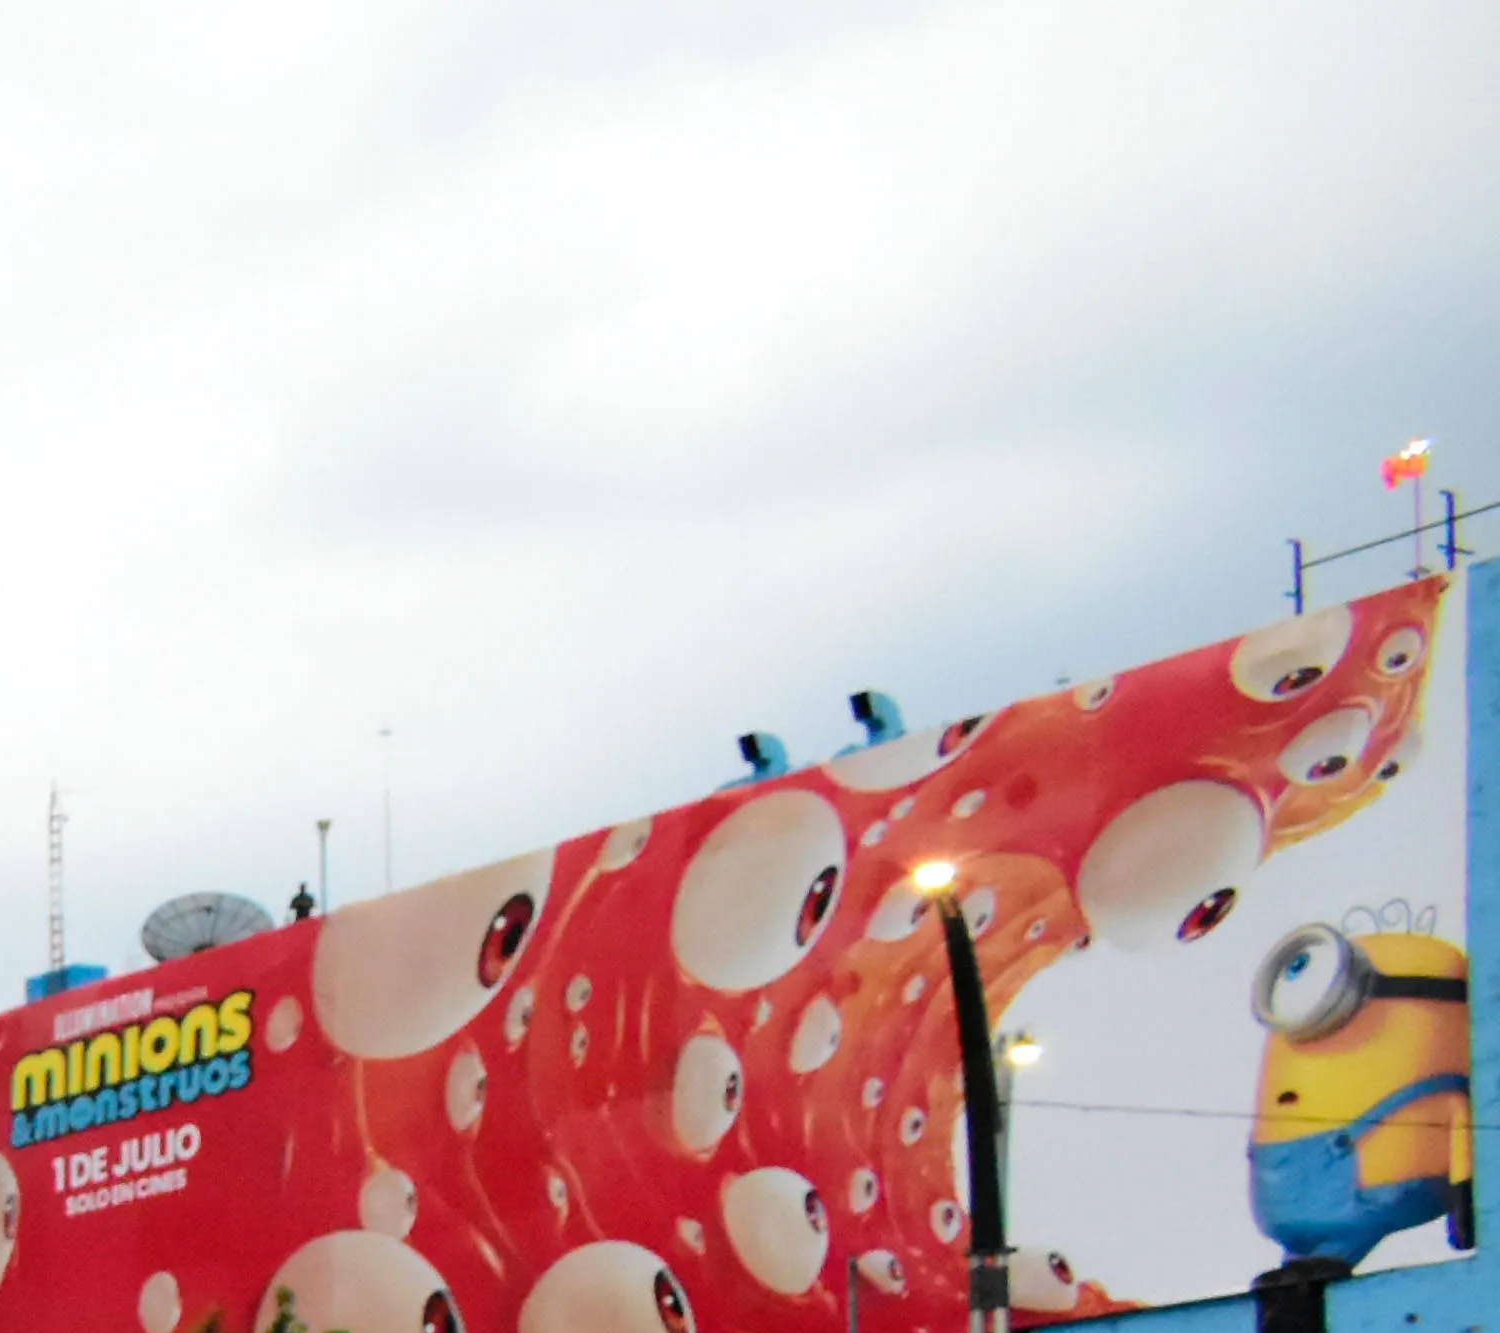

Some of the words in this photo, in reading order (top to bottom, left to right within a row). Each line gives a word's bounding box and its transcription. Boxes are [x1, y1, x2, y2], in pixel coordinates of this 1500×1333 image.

[52, 1155, 65, 1193] 1
[69, 1147, 109, 1190] DE
[111, 1122, 202, 1177] JULIO
